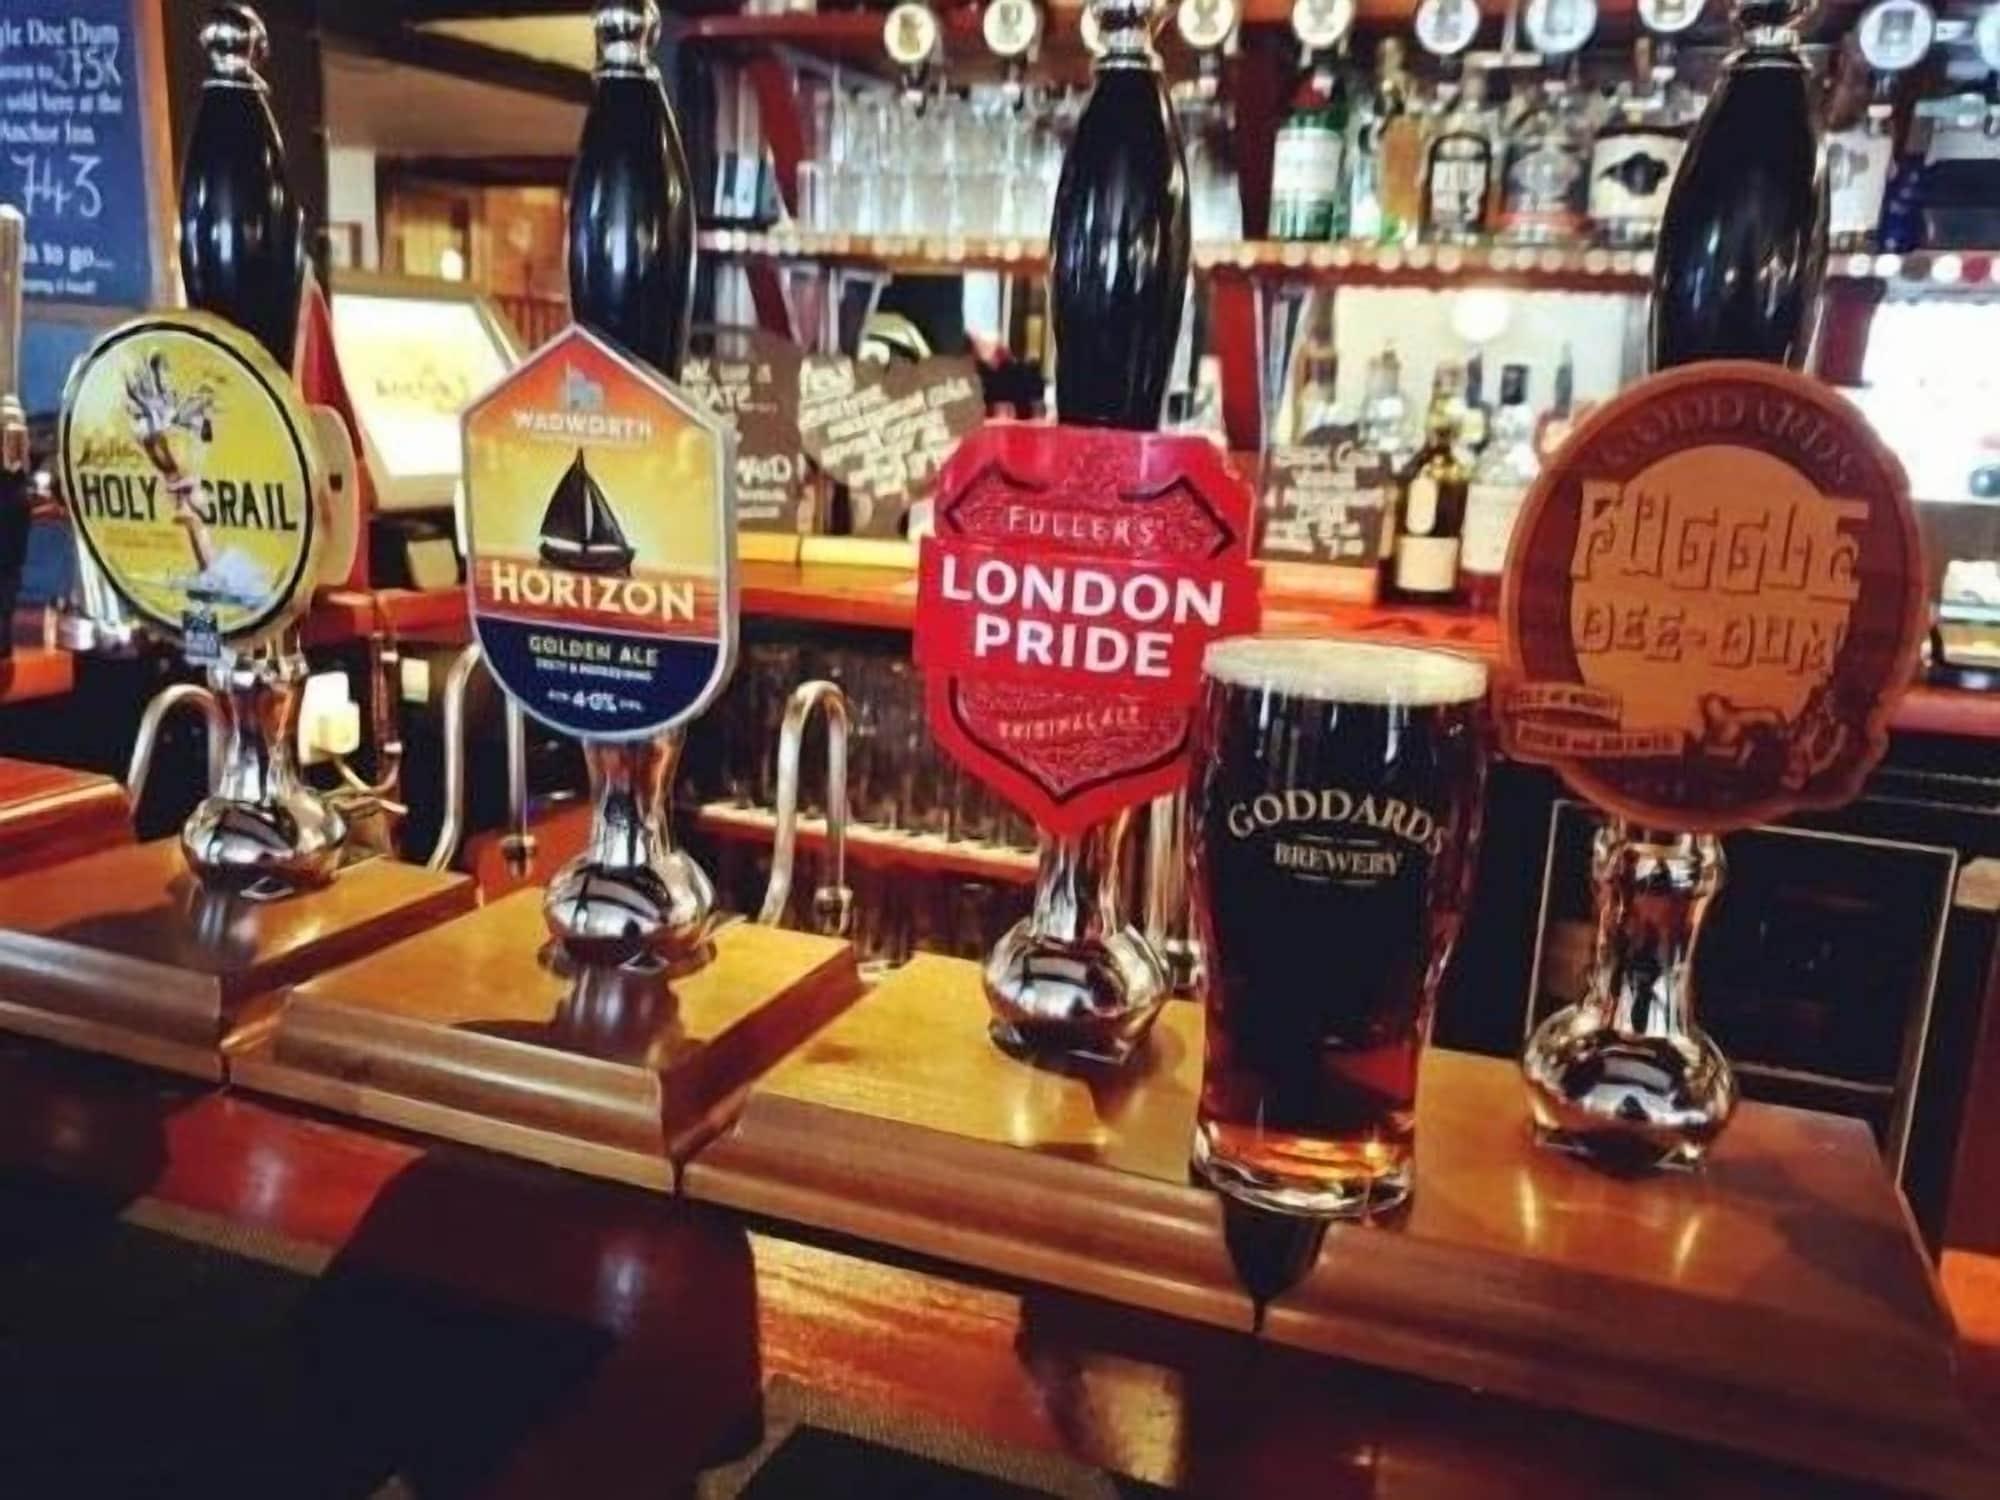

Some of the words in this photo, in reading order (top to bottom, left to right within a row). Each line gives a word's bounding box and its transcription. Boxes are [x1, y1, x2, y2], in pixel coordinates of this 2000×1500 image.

[79, 473, 157, 523] HOLY
[199, 480, 298, 532] GRAIL
[1573, 482, 1868, 602] FUGGLE
[492, 559, 696, 622] HORIZON
[940, 553, 1224, 627] LONDON
[529, 634, 612, 661] GOLDEN
[619, 646, 658, 668] ALE
[974, 612, 1174, 679] PRIDE
[1228, 788, 1446, 856] GODDARDS
[1274, 842, 1401, 877] BREWERY
